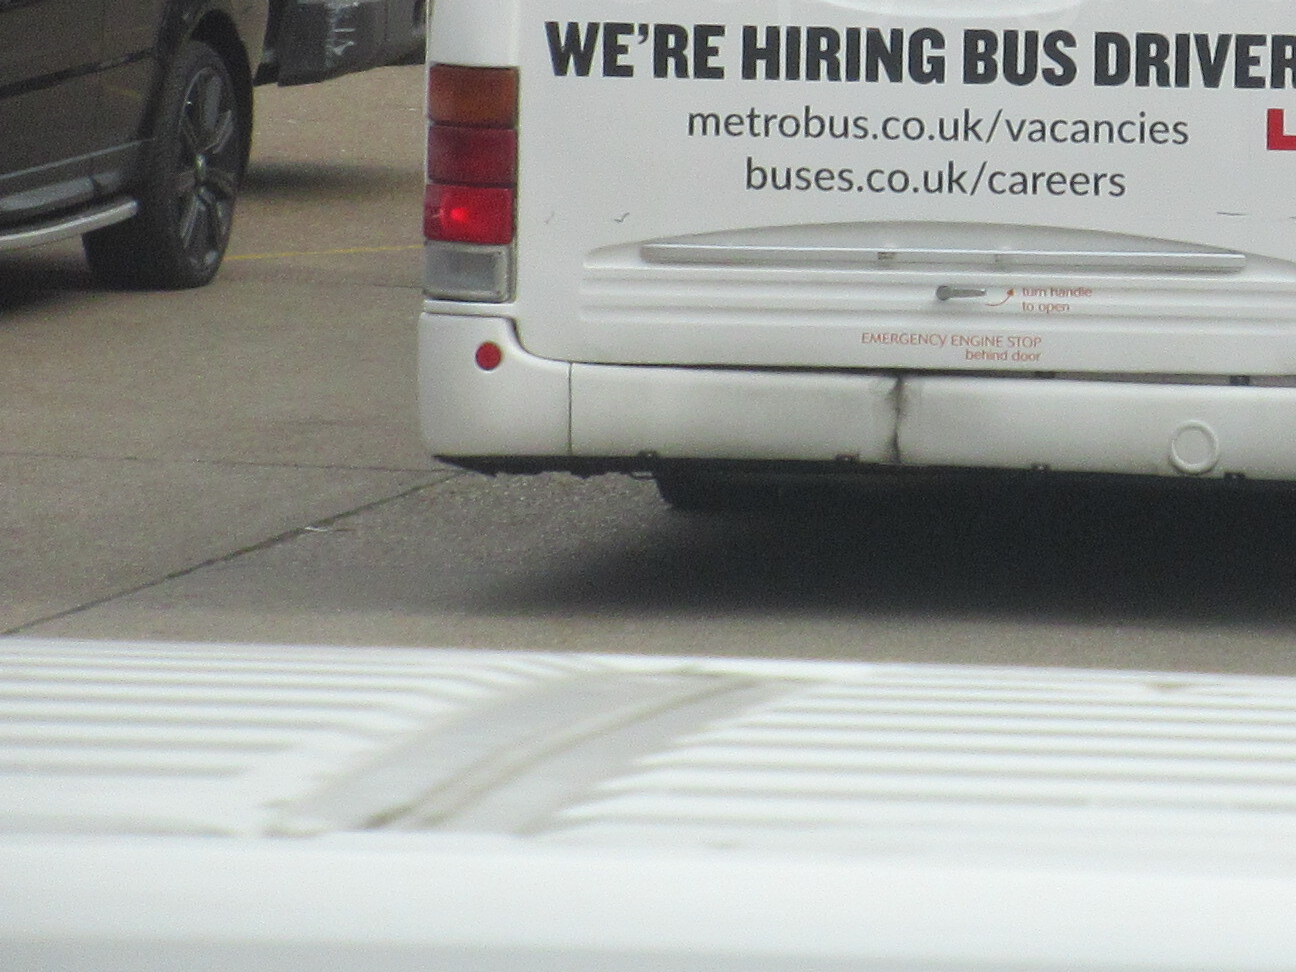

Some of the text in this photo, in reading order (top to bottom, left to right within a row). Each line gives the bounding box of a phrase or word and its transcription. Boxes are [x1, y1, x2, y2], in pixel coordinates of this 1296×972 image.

[544, 21, 726, 80] WE'RE
[741, 25, 946, 84] HIRING
[963, 29, 1077, 87] BUS
[687, 105, 1189, 145] metrobus.co.uk/vacancies
[745, 156, 1126, 196] buses.co.uk/careers
[1022, 287, 1093, 297] turn handle
[1022, 301, 1070, 314] to open
[861, 332, 1042, 348] EMERGENCY ENGINE STOP
[966, 349, 1041, 362] behind door
